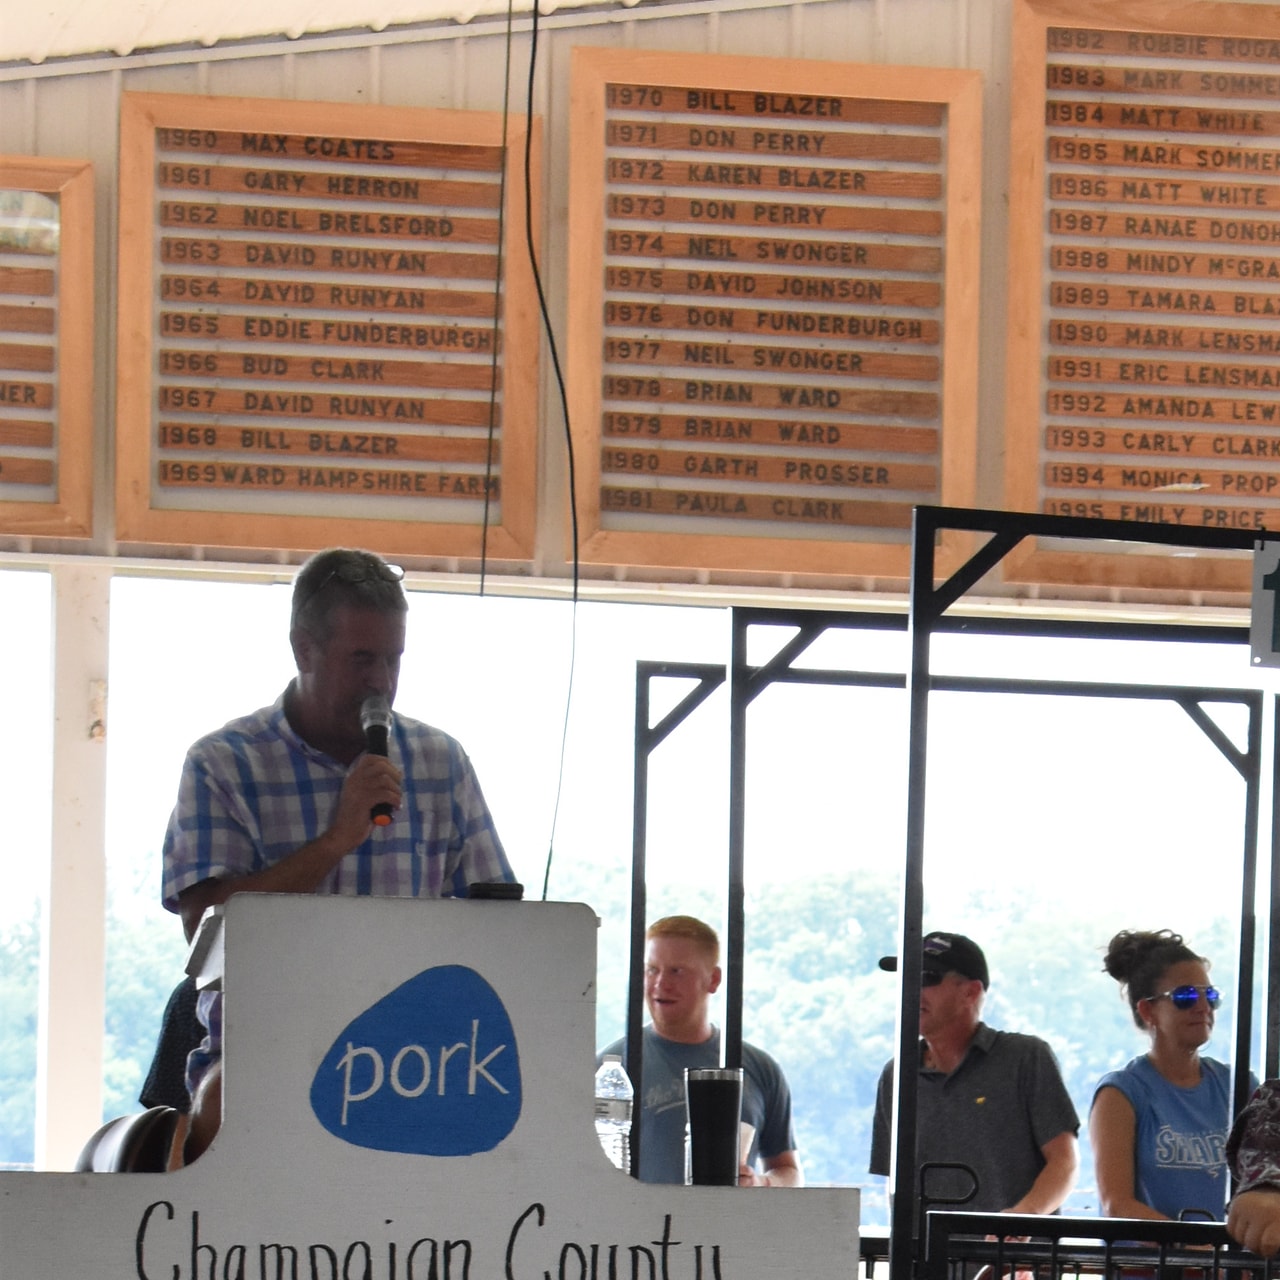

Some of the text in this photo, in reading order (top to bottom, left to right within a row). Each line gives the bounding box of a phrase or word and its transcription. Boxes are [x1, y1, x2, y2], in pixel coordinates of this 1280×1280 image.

[1051, 104, 1264, 131] 1984 MATT WHITE
[1054, 141, 1108, 161] 1985
[1123, 145, 1181, 164] MARK
[161, 168, 419, 199] 1961 GARY HERRON
[611, 161, 866, 190] 1972 KAREN BLAZER
[1055, 178, 1267, 205] 1986 MATT WHITE
[162, 205, 453, 237] 1962 NOEL BRELSFORD
[1055, 214, 1108, 233] 1987
[1125, 217, 1196, 238] RANAE
[165, 241, 427, 272] 1963 DAVID RUNYAN
[610, 234, 868, 264] 1974 NEIL SWONGER
[1056, 249, 1108, 268] 1988
[1127, 253, 1195, 273] MINDY
[609, 270, 883, 300] 1975 DAVID JOHNSON
[1056, 286, 1108, 305] 1989
[1127, 290, 1216, 312] TAMARA
[162, 314, 491, 348] 1965 EDDIE FUNDERBURGH
[609, 305, 921, 338] 1976 DON FUNDERBURGH
[1056, 323, 1107, 342] 1990
[1126, 327, 1184, 347] MARK
[162, 353, 385, 381] 1966 BUD CLARK
[608, 343, 863, 371] 1977 NEIL SWONGER
[1056, 360, 1101, 378] 1991
[1120, 363, 1169, 382] ERIC
[1053, 394, 1106, 413] 1992
[1123, 398, 1215, 418] AMANDA
[161, 426, 398, 454] 1968 BILL BLAZER
[1053, 429, 1105, 448] 1993
[1123, 433, 1194, 453] CARLY
[162, 463, 216, 482] 1969
[220, 466, 285, 485] WARD
[298, 469, 426, 492] HAMPSHIRE
[336, 1018, 508, 1125] pork
